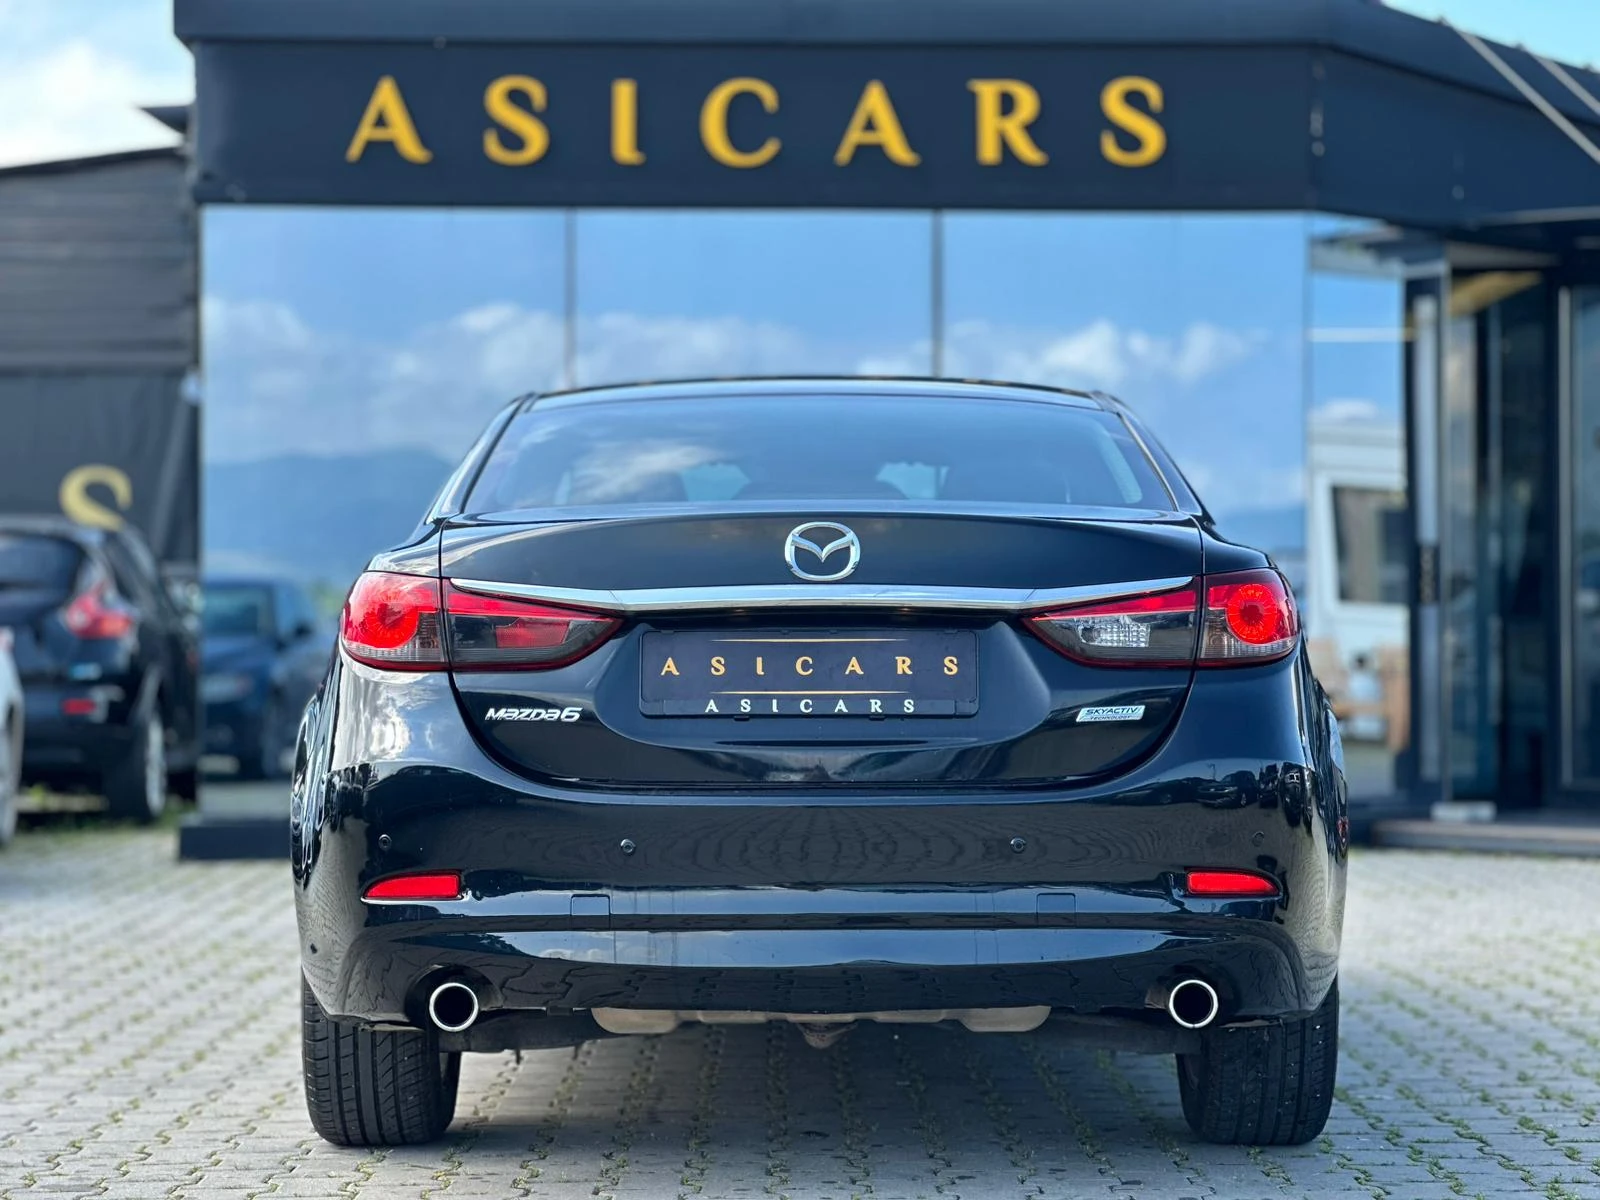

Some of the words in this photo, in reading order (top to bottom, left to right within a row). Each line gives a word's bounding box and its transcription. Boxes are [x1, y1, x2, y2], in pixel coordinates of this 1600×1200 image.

[346, 74, 1167, 168] ASICARS
[660, 656, 961, 676] ASICARS
[705, 699, 916, 714] ASICARS
[1085, 707, 1138, 715] SKYACTIV
